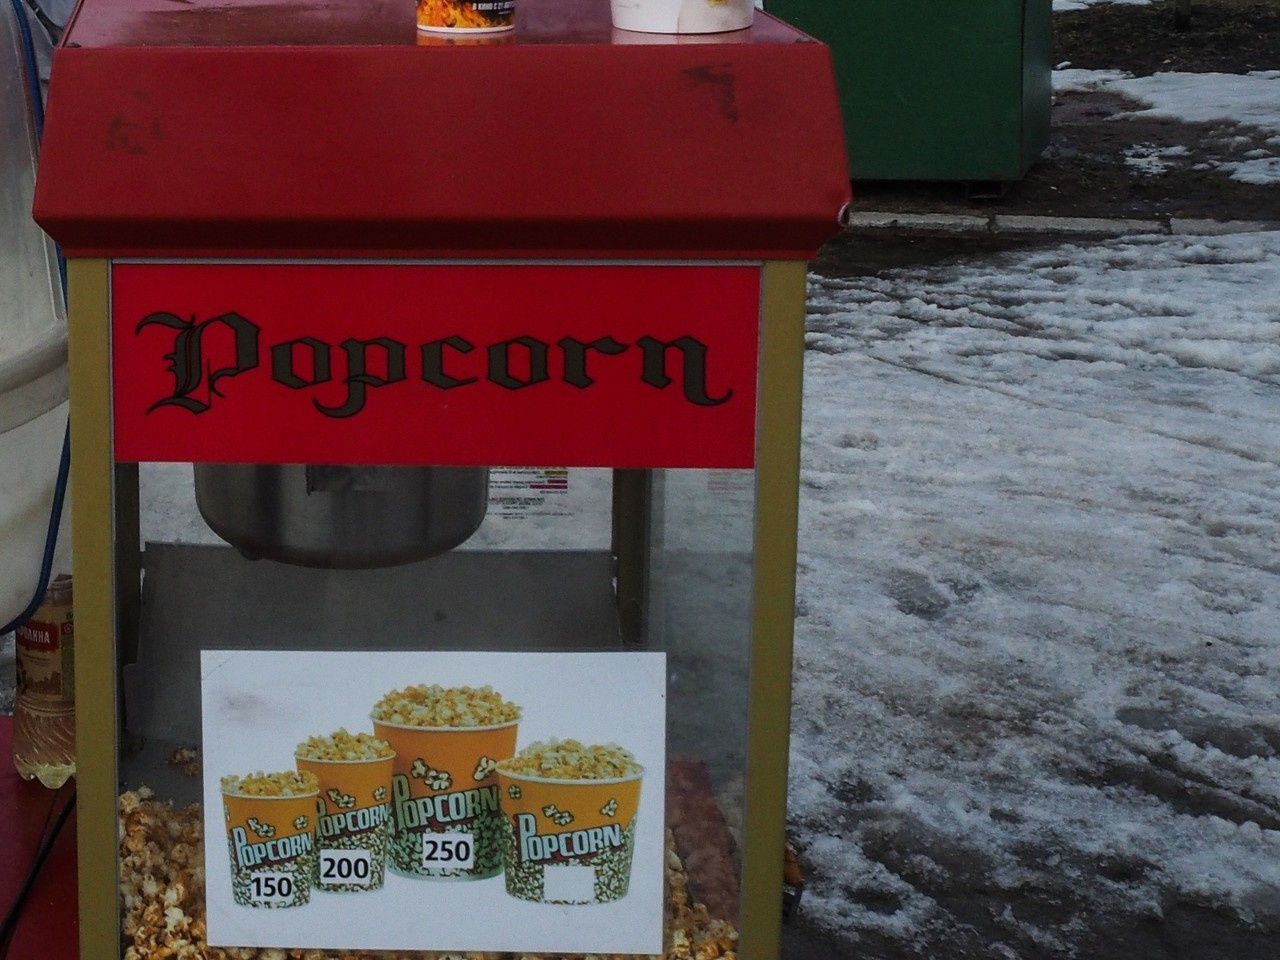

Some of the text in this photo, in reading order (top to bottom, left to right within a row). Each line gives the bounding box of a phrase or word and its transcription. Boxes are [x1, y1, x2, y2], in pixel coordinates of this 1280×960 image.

[135, 310, 734, 418] Popcorn
[392, 775, 499, 832] POPCORN
[233, 827, 313, 870] POPCORN
[425, 841, 471, 861] 250
[519, 813, 621, 862] POPCORN
[252, 877, 292, 897] 150
[322, 858, 369, 879] 200
